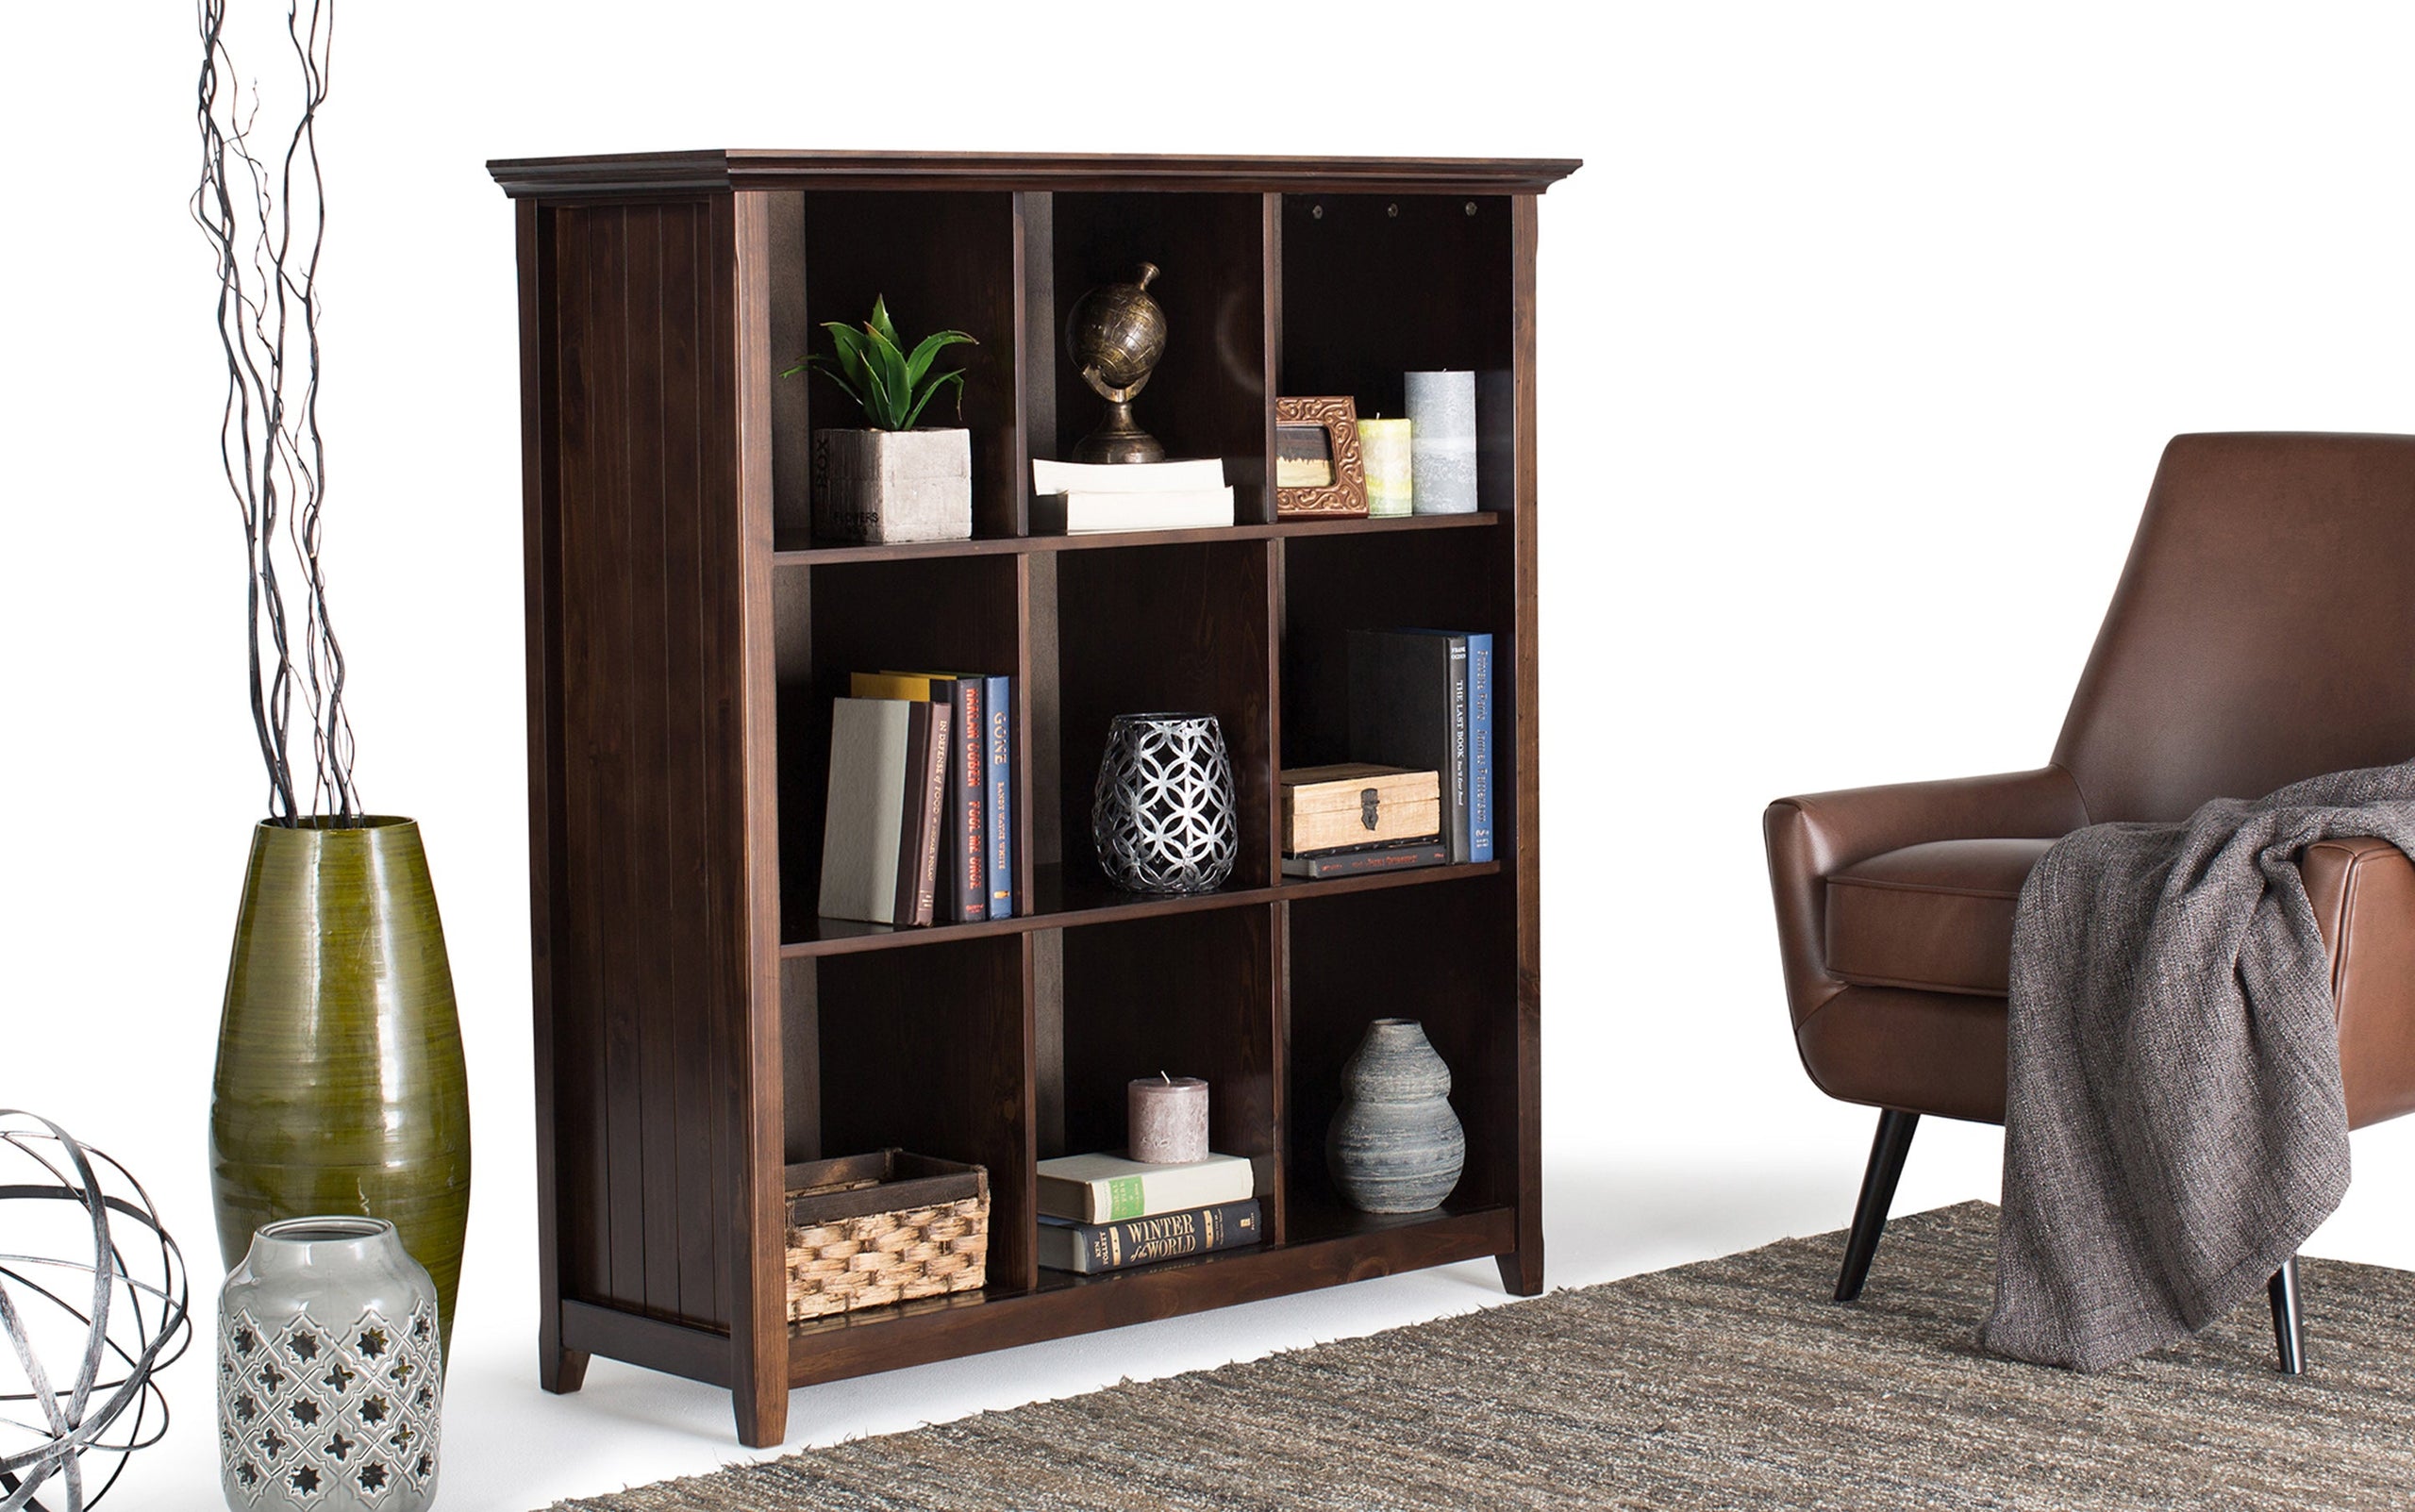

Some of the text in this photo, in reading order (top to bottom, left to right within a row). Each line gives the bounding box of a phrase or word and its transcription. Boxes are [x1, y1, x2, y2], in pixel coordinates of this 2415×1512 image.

[940, 721, 947, 732] IN
[966, 689, 980, 787] HARLAN COBEN
[994, 711, 1007, 765] GONE
[936, 734, 946, 774] DEFENSE
[1476, 729, 1488, 765] James
[933, 787, 941, 814] FOOD
[1477, 769, 1489, 822] Patterson
[968, 801, 981, 833] FOOL
[969, 836, 981, 853] ME
[969, 856, 982, 889] ONCE
[1126, 1213, 1195, 1243] WINTER
[1100, 1232, 1108, 1265] FOLLETT
[1145, 1234, 1197, 1258] WORLD
